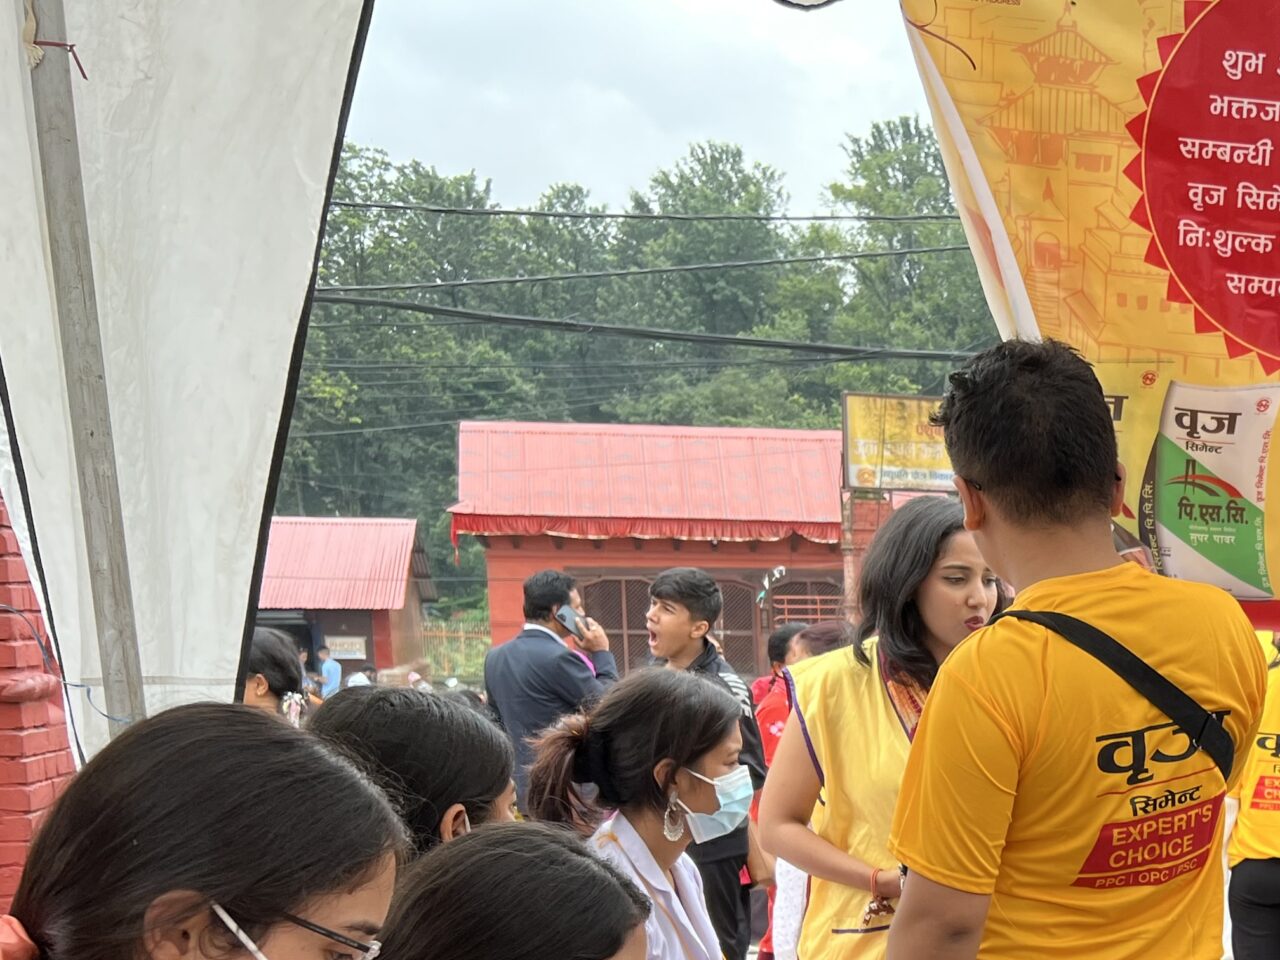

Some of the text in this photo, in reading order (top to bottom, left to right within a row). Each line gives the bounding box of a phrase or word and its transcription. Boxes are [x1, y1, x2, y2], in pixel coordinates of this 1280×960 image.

[1222, 50, 1266, 80] शुभ
[1178, 137, 1273, 167] सम्बन्धी
[1187, 182, 1227, 211] वृज
[1174, 406, 1242, 438] वृज
[1178, 497, 1249, 525] पि.एस.सि.
[1130, 785, 1202, 817] सिमेन्ट
[1108, 834, 1194, 868] CHOICE
[1095, 876, 1126, 888] PPC
[1138, 870, 1169, 883] OPC
[1177, 858, 1197, 875] PSC
